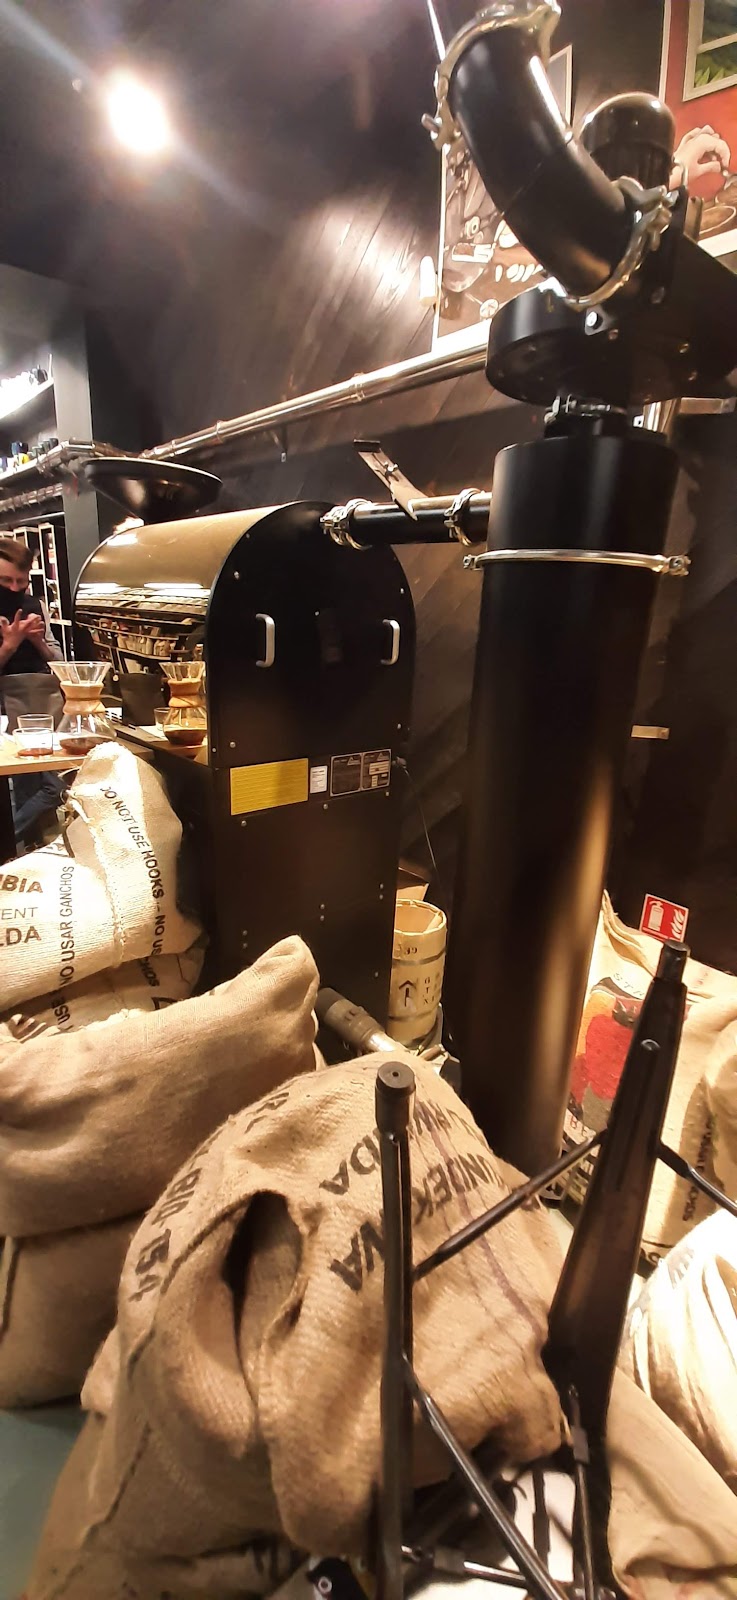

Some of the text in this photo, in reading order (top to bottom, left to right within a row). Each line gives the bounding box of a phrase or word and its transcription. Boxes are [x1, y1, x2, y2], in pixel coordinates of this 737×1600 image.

[0, 874, 43, 893] BIA
[59, 866, 74, 917] GANCHOS
[128, 826, 150, 849] USE
[141, 849, 165, 899] HOOKS
[154, 914, 166, 936] NO
[0, 907, 38, 920] ENT
[60, 921, 75, 961] USAR
